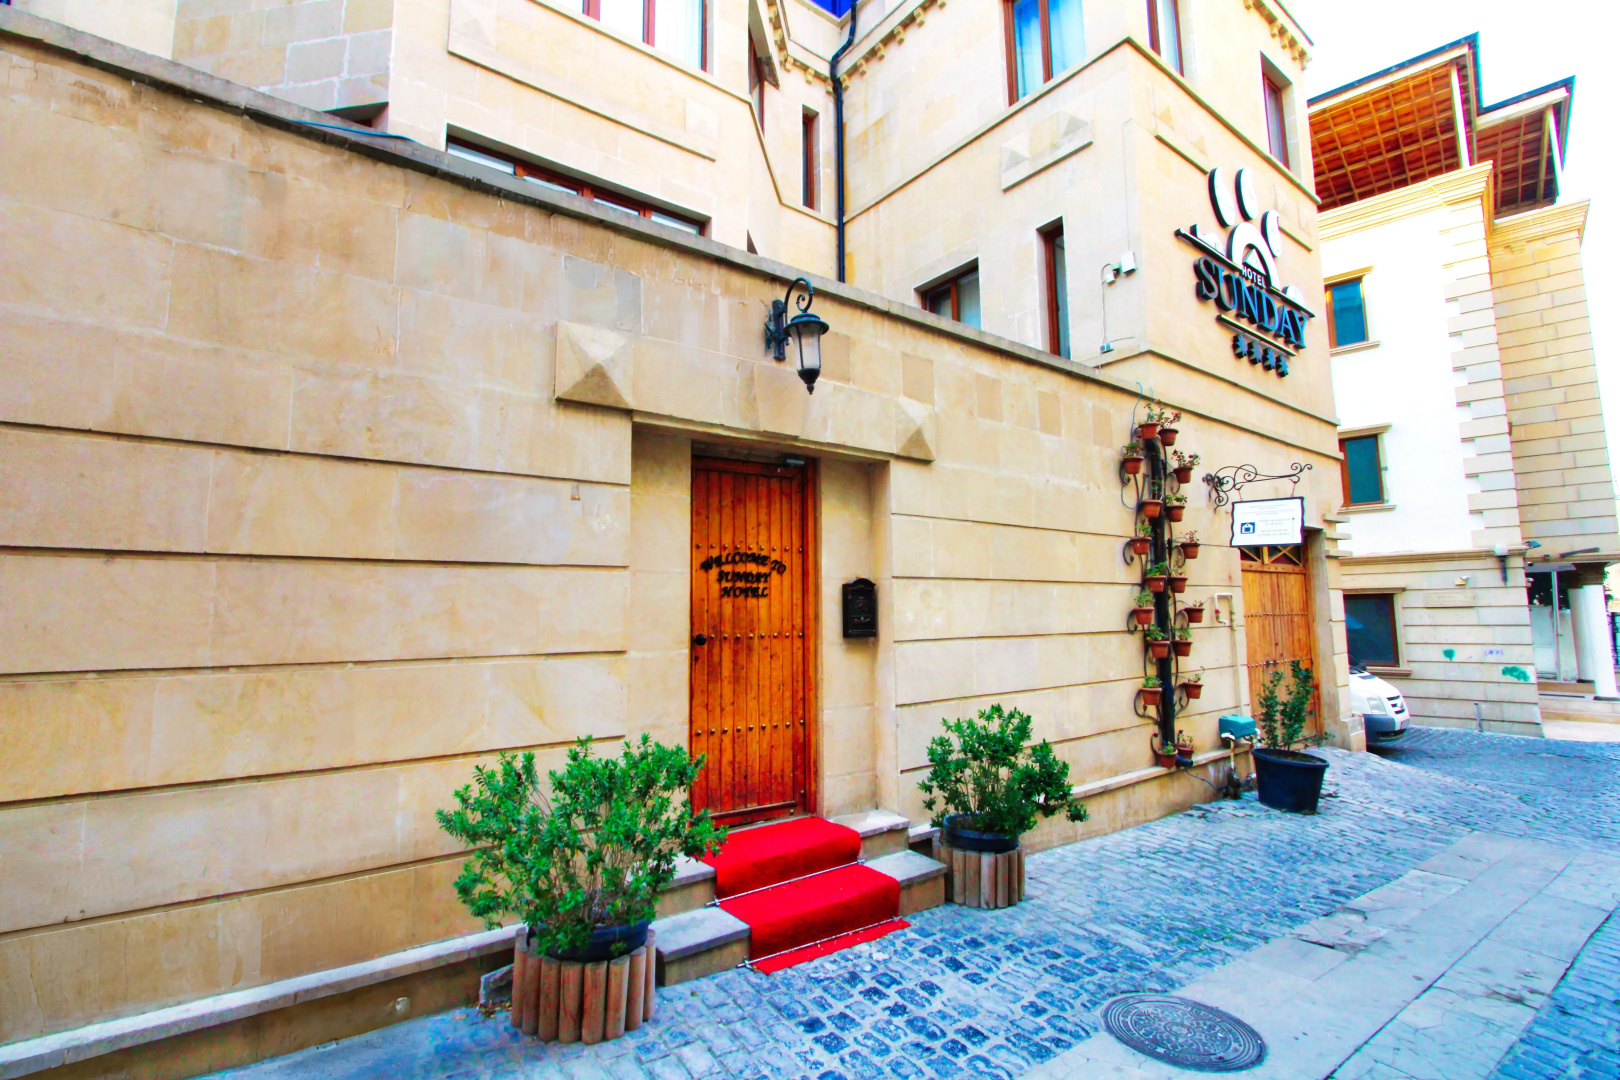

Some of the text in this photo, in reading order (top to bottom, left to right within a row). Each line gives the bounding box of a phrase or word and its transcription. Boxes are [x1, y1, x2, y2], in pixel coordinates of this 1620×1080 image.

[1241, 265, 1267, 289] HOTEL
[1193, 256, 1309, 349] SUNDAY
[700, 551, 787, 575] WELCOME TO
[716, 570, 772, 584] SUNDAY
[721, 586, 769, 599] HOTEL
